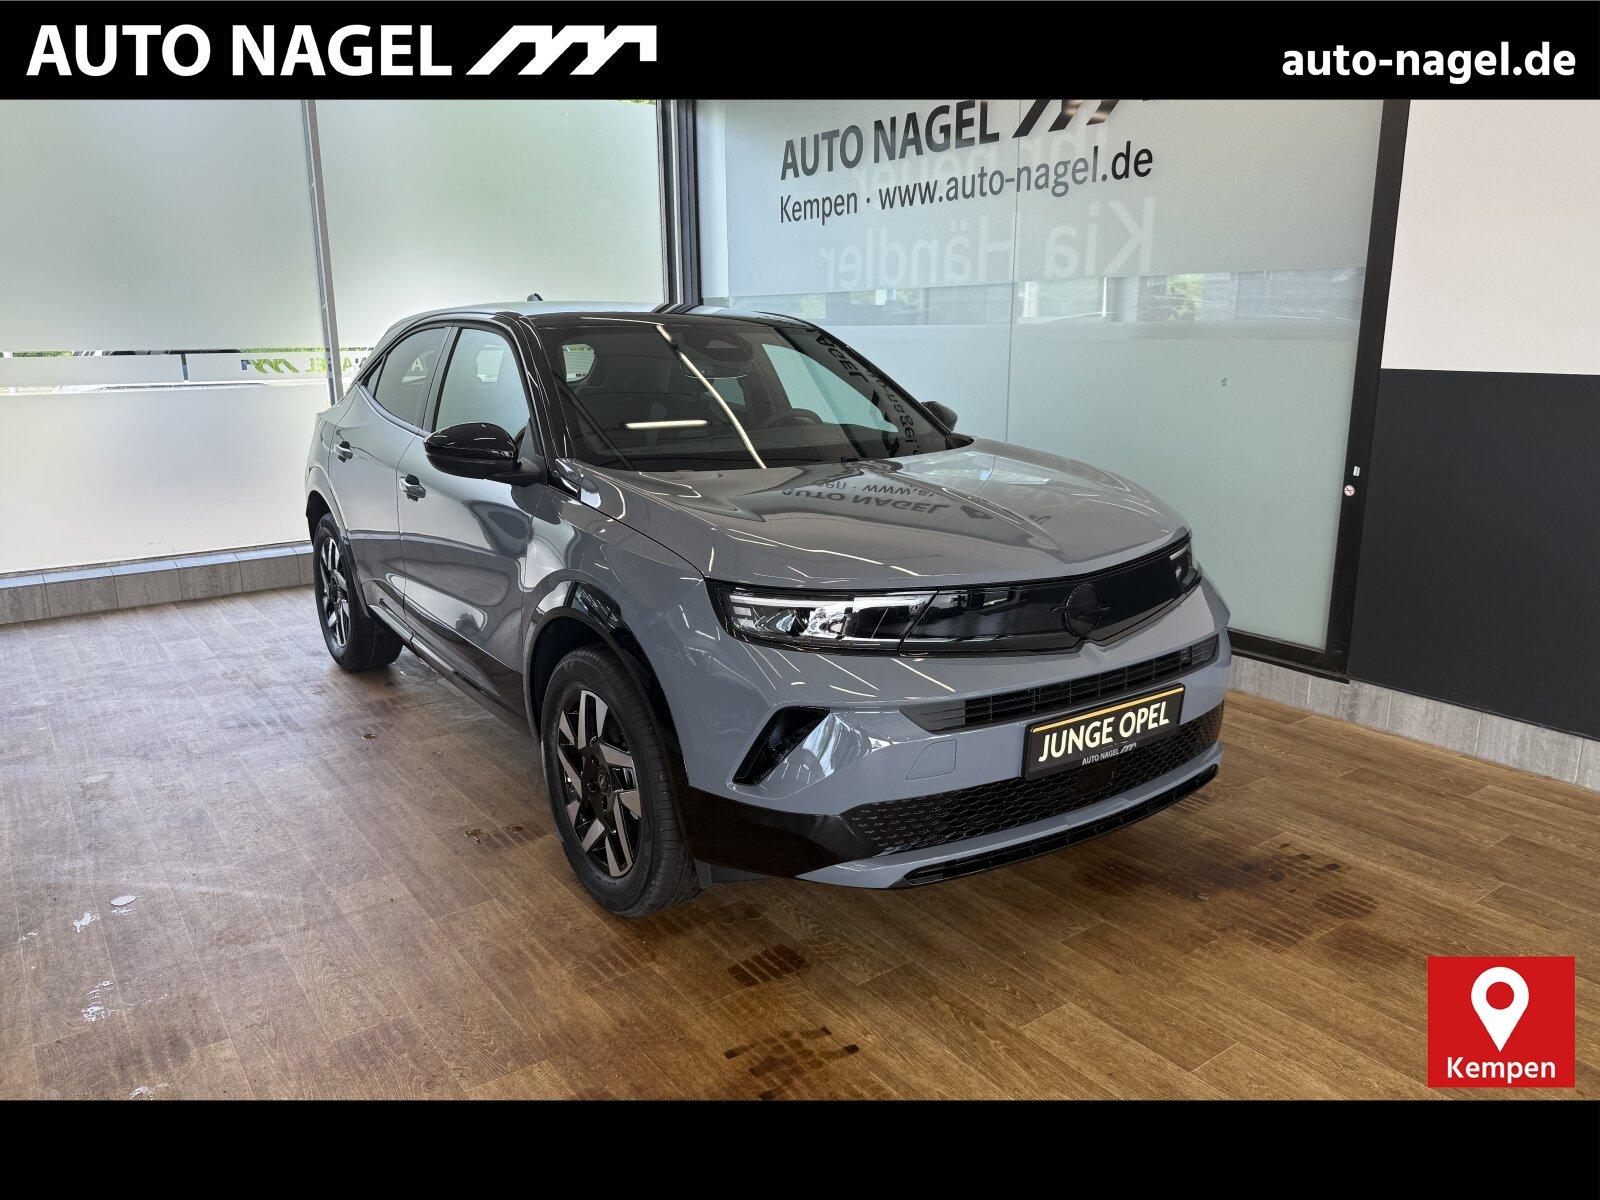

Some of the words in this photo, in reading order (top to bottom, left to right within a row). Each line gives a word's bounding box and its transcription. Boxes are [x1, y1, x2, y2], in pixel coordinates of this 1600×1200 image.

[780, 124, 864, 181] AUTO
[873, 99, 999, 164] NAGEL
[780, 193, 858, 226] Kempen
[878, 140, 1154, 210] www.auto-nagel.de
[1038, 716, 1115, 763] JUNGE
[1119, 700, 1170, 739] OPEL
[1081, 753, 1100, 766] AUTO
[1100, 747, 1120, 761] NAGEL
